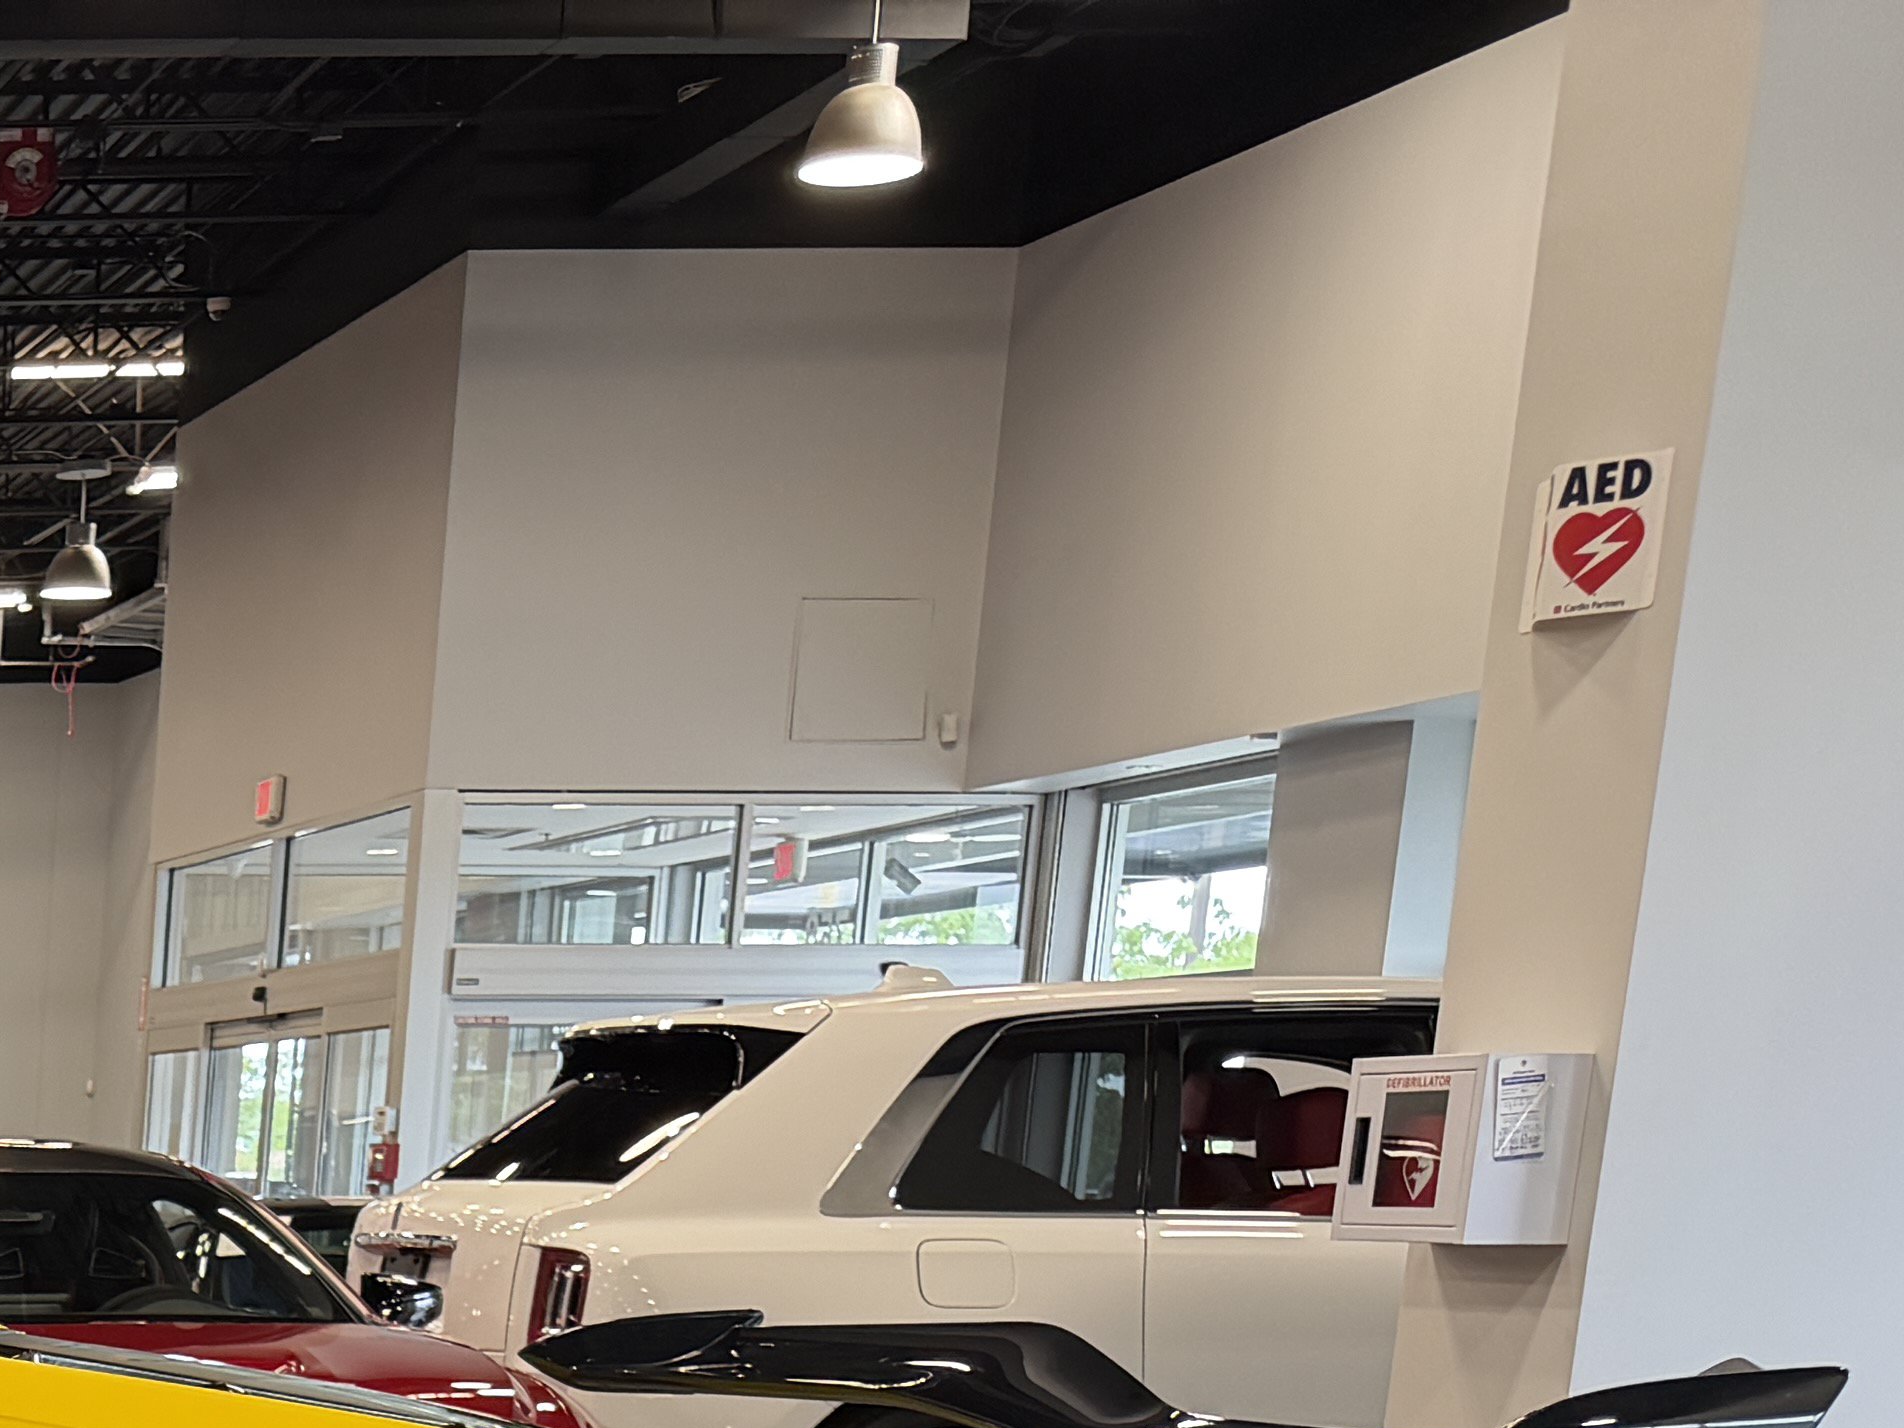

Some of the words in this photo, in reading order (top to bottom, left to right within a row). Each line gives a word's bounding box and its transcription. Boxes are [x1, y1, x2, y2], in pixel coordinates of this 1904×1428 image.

[1557, 458, 1652, 509] AED
[1563, 604, 1590, 613] Cardio
[1592, 600, 1625, 609] Partners
[1386, 1075, 1452, 1089] DEFIBRILLATOR
